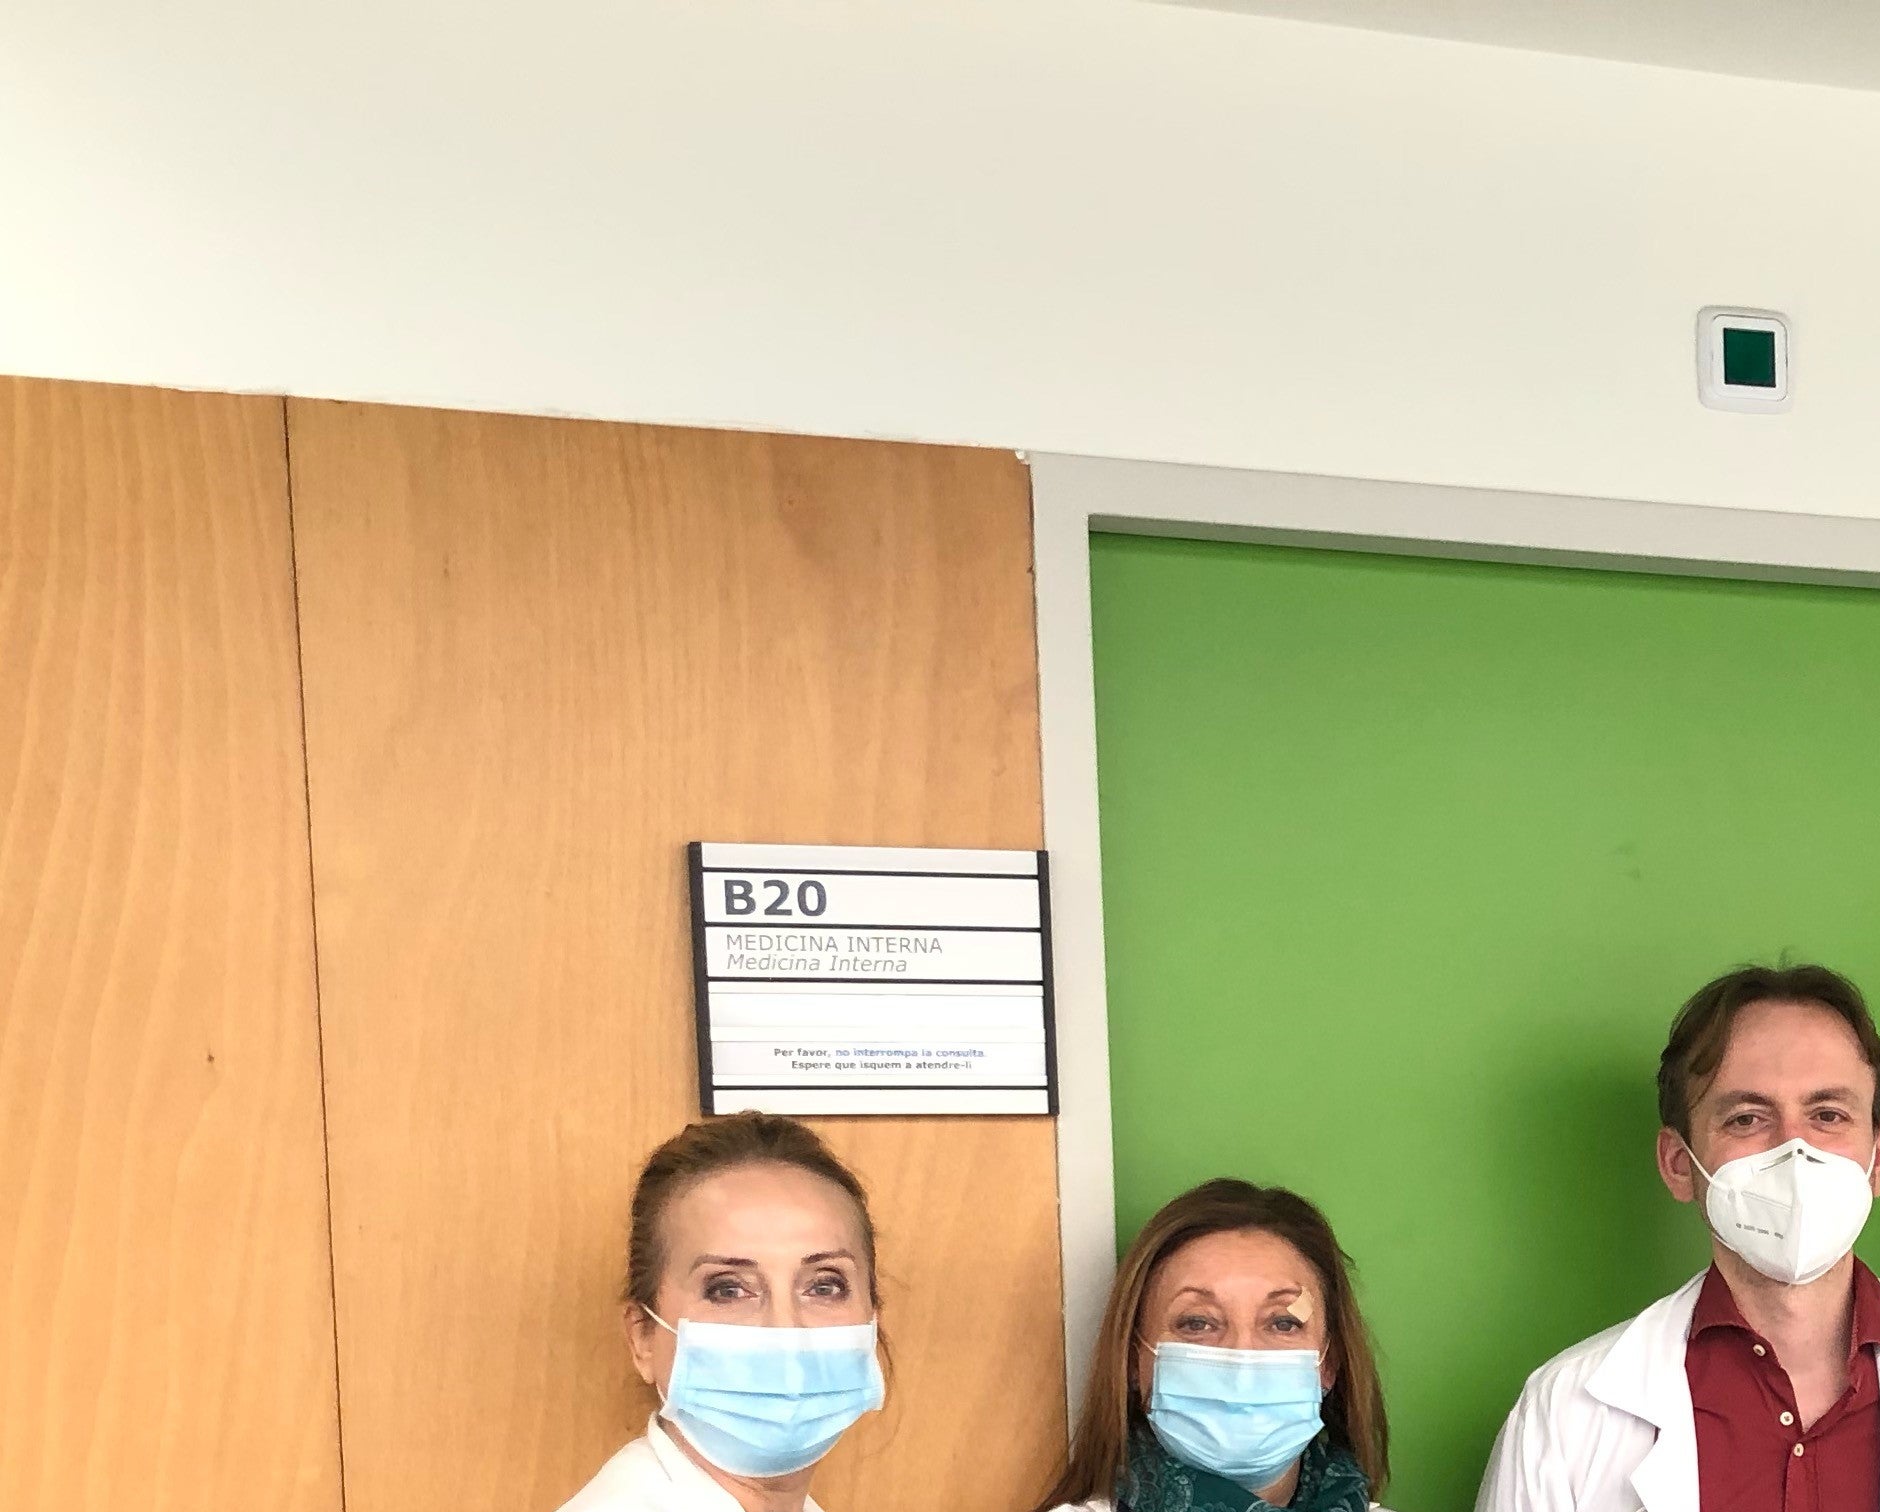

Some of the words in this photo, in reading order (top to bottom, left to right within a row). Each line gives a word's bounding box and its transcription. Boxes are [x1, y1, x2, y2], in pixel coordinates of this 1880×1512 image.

[723, 879, 827, 917] B20
[726, 934, 839, 952] MEDICINA
[847, 936, 943, 954] INTERNA
[726, 953, 821, 971] Medicina
[829, 955, 908, 972] Interna
[773, 1047, 794, 1057] Per
[797, 1047, 831, 1058] favor,
[835, 1049, 850, 1057] no
[791, 1060, 831, 1071] Espere
[834, 1061, 856, 1071] que
